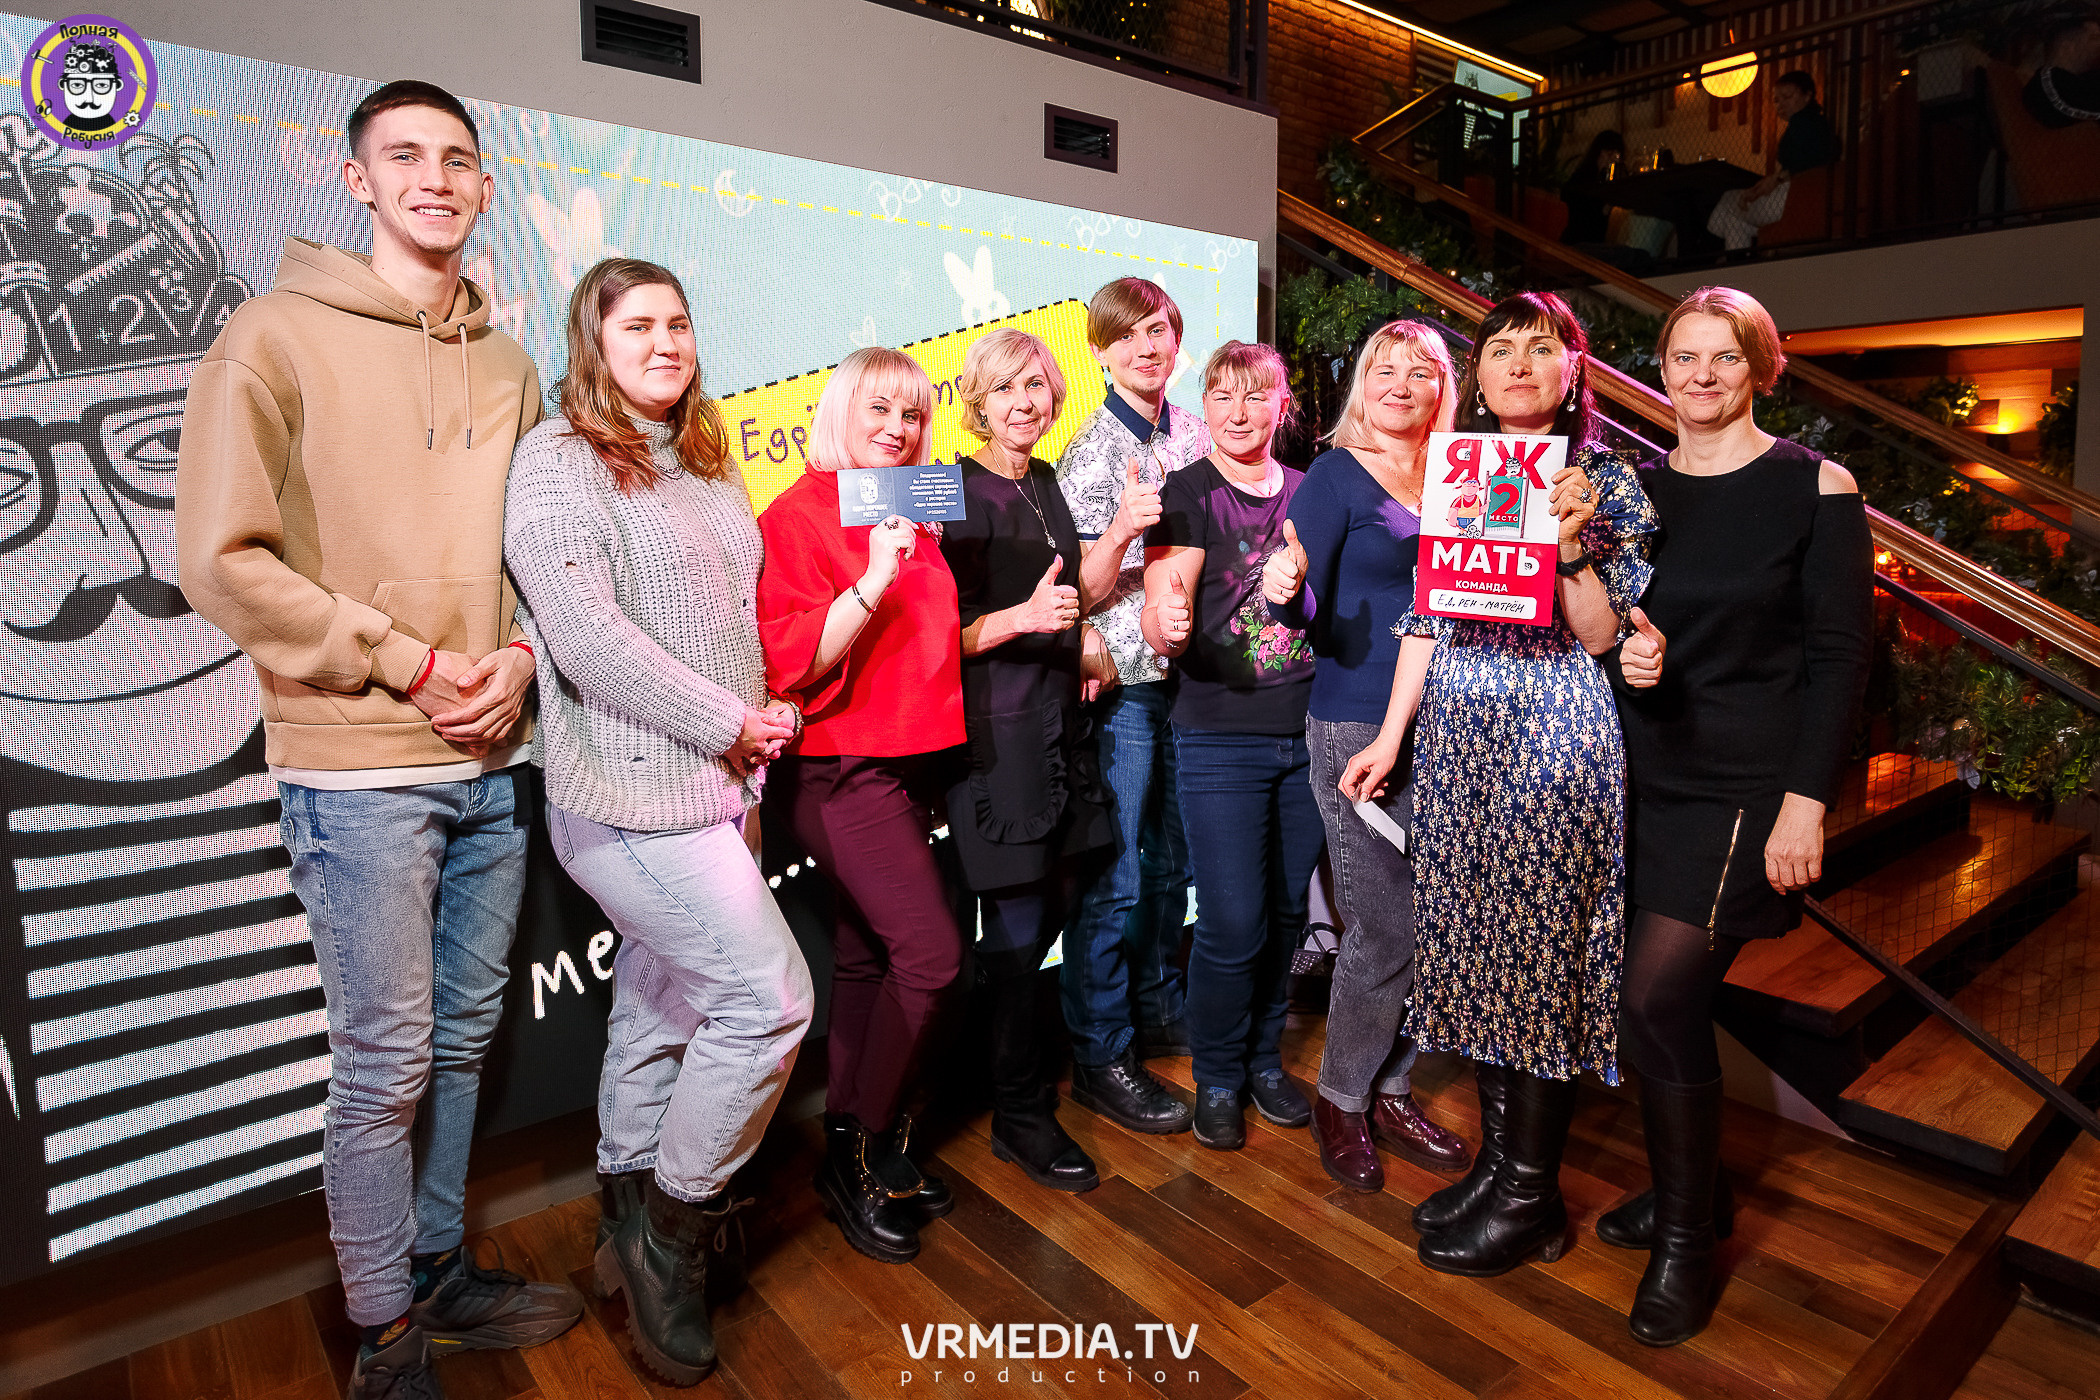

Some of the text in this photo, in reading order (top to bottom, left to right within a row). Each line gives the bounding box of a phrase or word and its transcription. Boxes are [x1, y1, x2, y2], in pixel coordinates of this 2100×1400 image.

[108, 293, 156, 346] 2
[1491, 482, 1520, 515] 2
[1489, 514, 1519, 522] МЕСТО
[1431, 540, 1540, 577] МАТЬ
[1455, 579, 1509, 593] КОМАНДА
